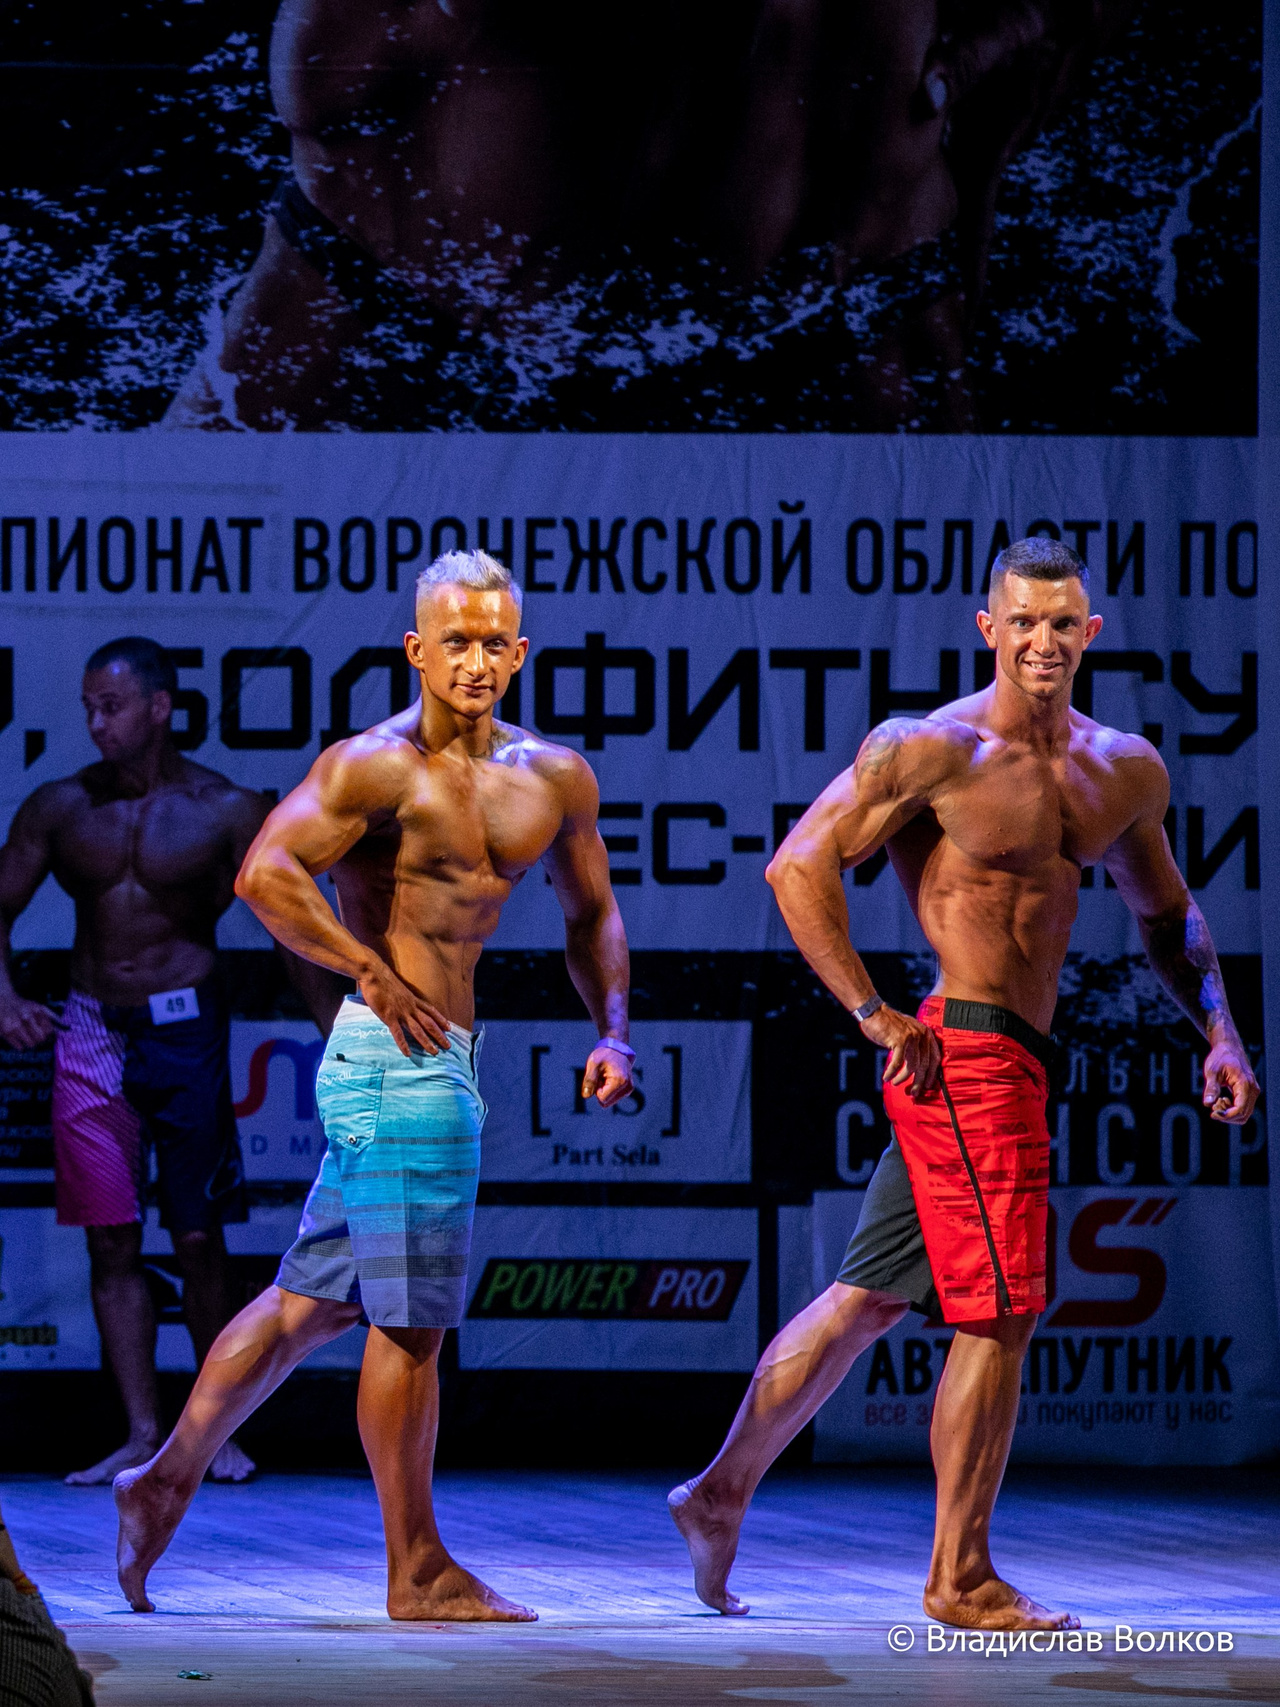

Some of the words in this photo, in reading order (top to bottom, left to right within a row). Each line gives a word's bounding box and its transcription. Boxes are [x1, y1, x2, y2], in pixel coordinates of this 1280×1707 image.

[846, 517, 1146, 597] ОБЛАТИ
[1180, 520, 1258, 598] ПО
[165, 996, 186, 1013] 49
[552, 1143, 604, 1166] Part
[612, 1143, 661, 1166] Sela
[482, 1264, 637, 1312] POWER
[648, 1268, 726, 1309] PRO
[864, 1404, 907, 1424] все
[1038, 1403, 1155, 1431] покупают
[1190, 1399, 1233, 1423] нас
